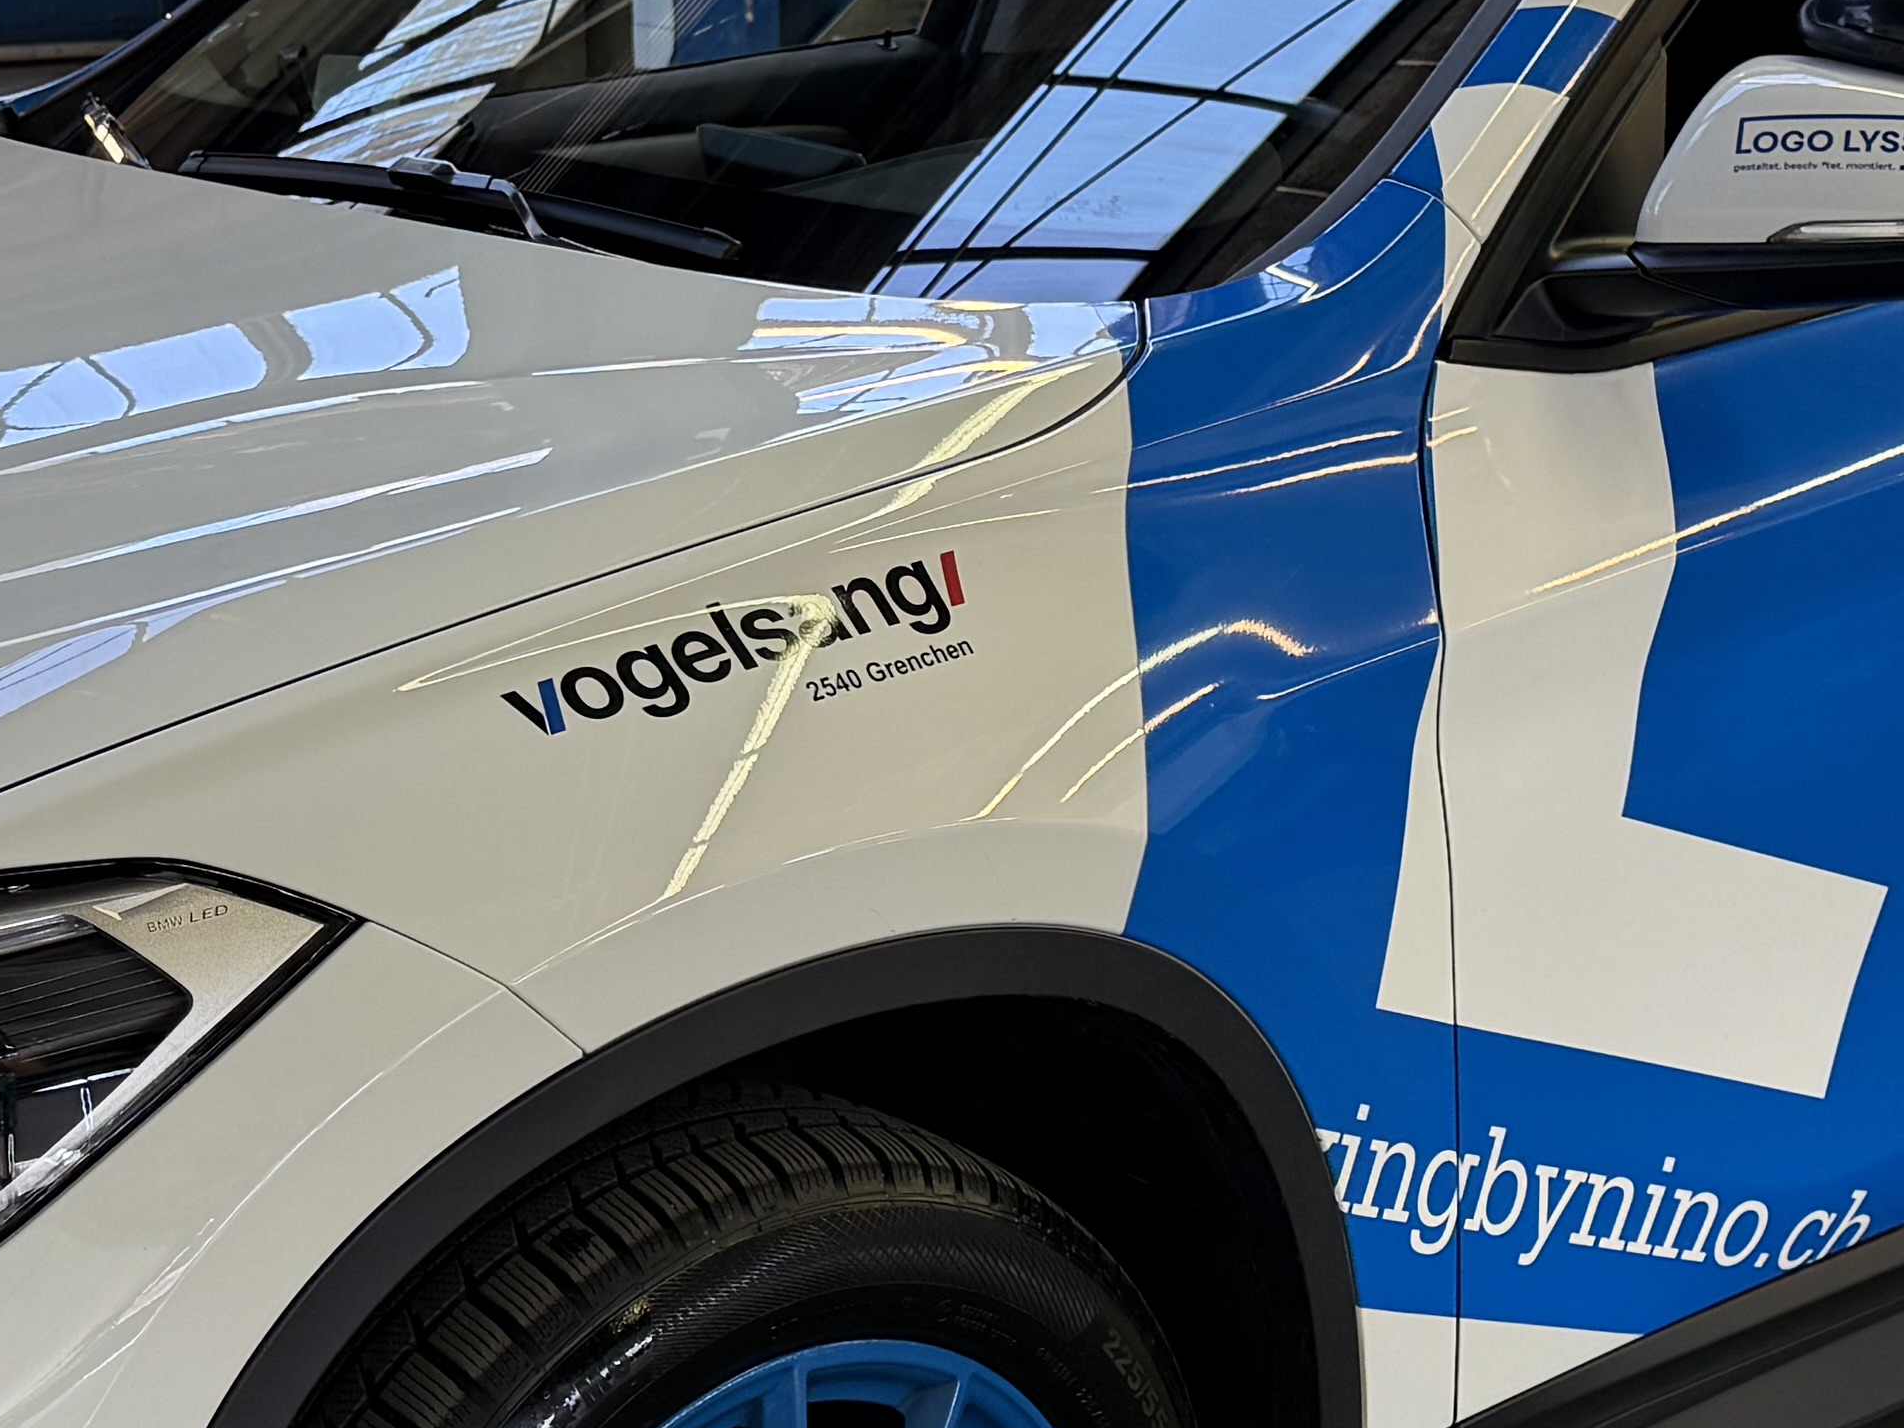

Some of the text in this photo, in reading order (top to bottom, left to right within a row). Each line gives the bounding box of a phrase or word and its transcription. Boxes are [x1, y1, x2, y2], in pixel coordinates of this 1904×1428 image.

[1735, 126, 1834, 154] LOGO
[806, 638, 975, 702] 2540 Grenchen
[146, 904, 228, 933] BMW LED
